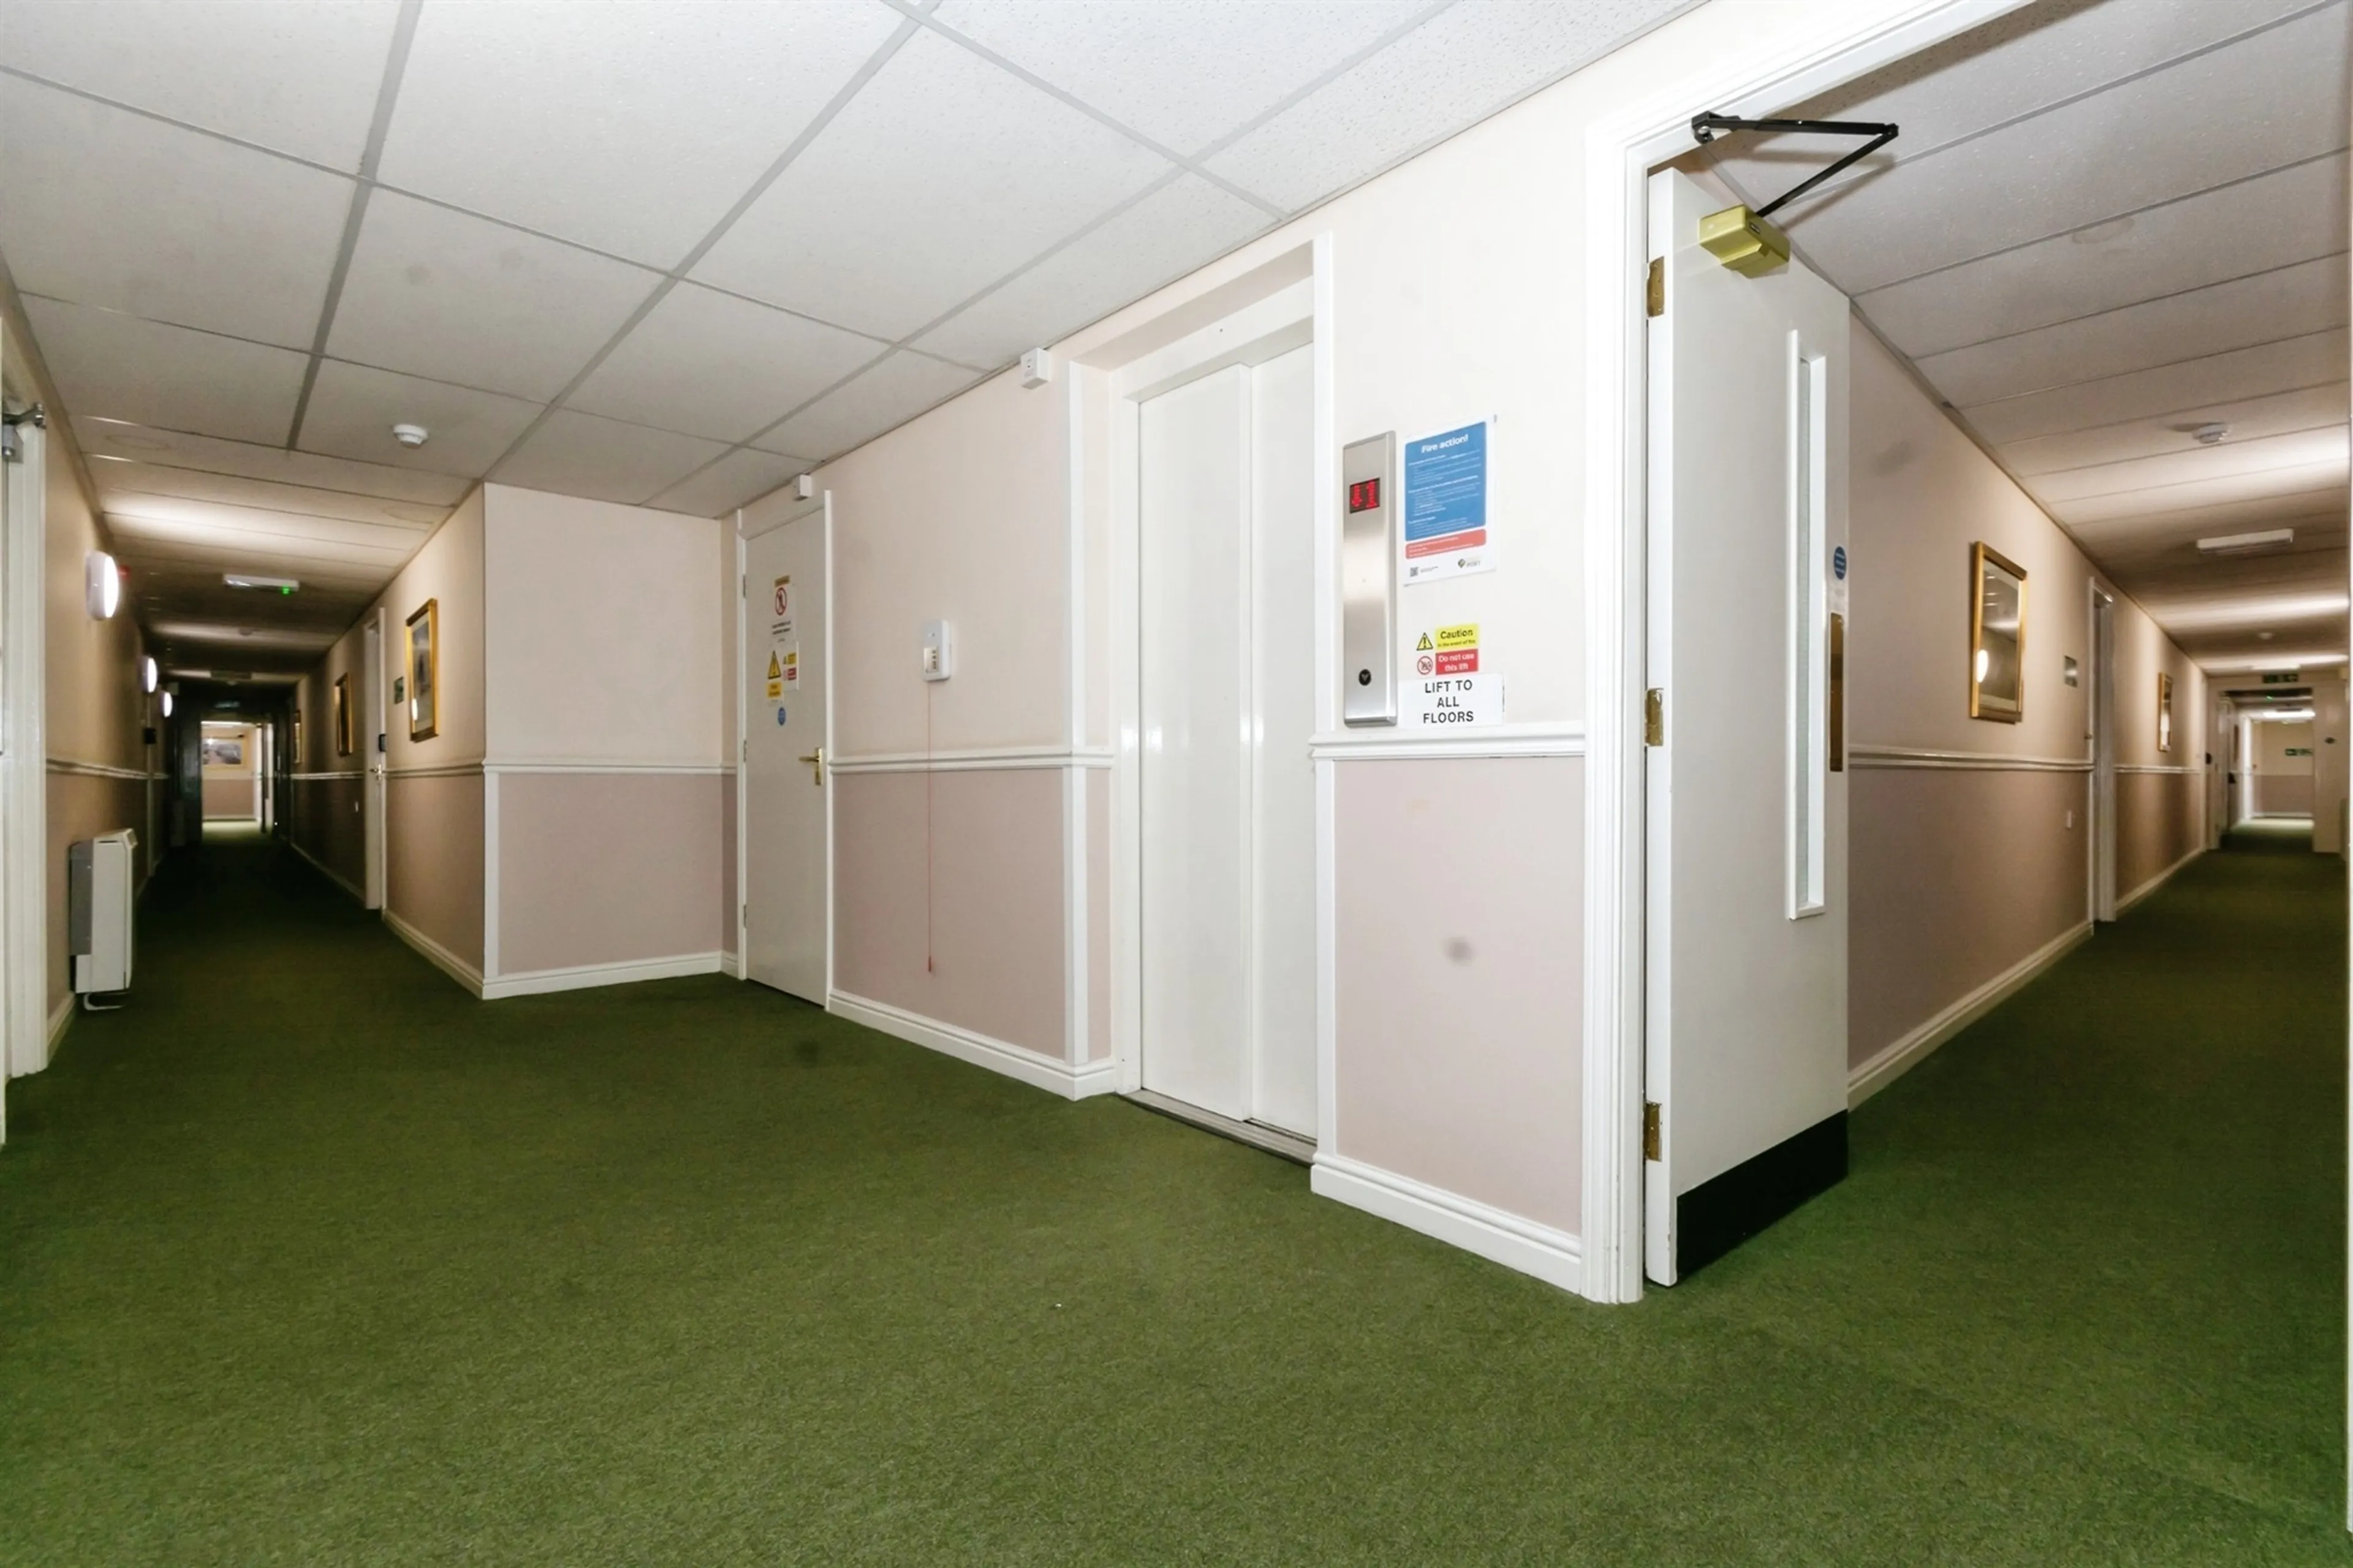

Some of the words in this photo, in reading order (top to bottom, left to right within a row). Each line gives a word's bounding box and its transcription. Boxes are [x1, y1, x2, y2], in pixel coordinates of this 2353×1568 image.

[1421, 444, 1438, 453] Fire
[1439, 434, 1468, 449] action!
[1440, 629, 1474, 640] Caution
[1425, 681, 1451, 694] LIFT
[1455, 680, 1473, 691] TO
[1437, 696, 1460, 708] ALL
[1423, 711, 1474, 724] FLOORS
